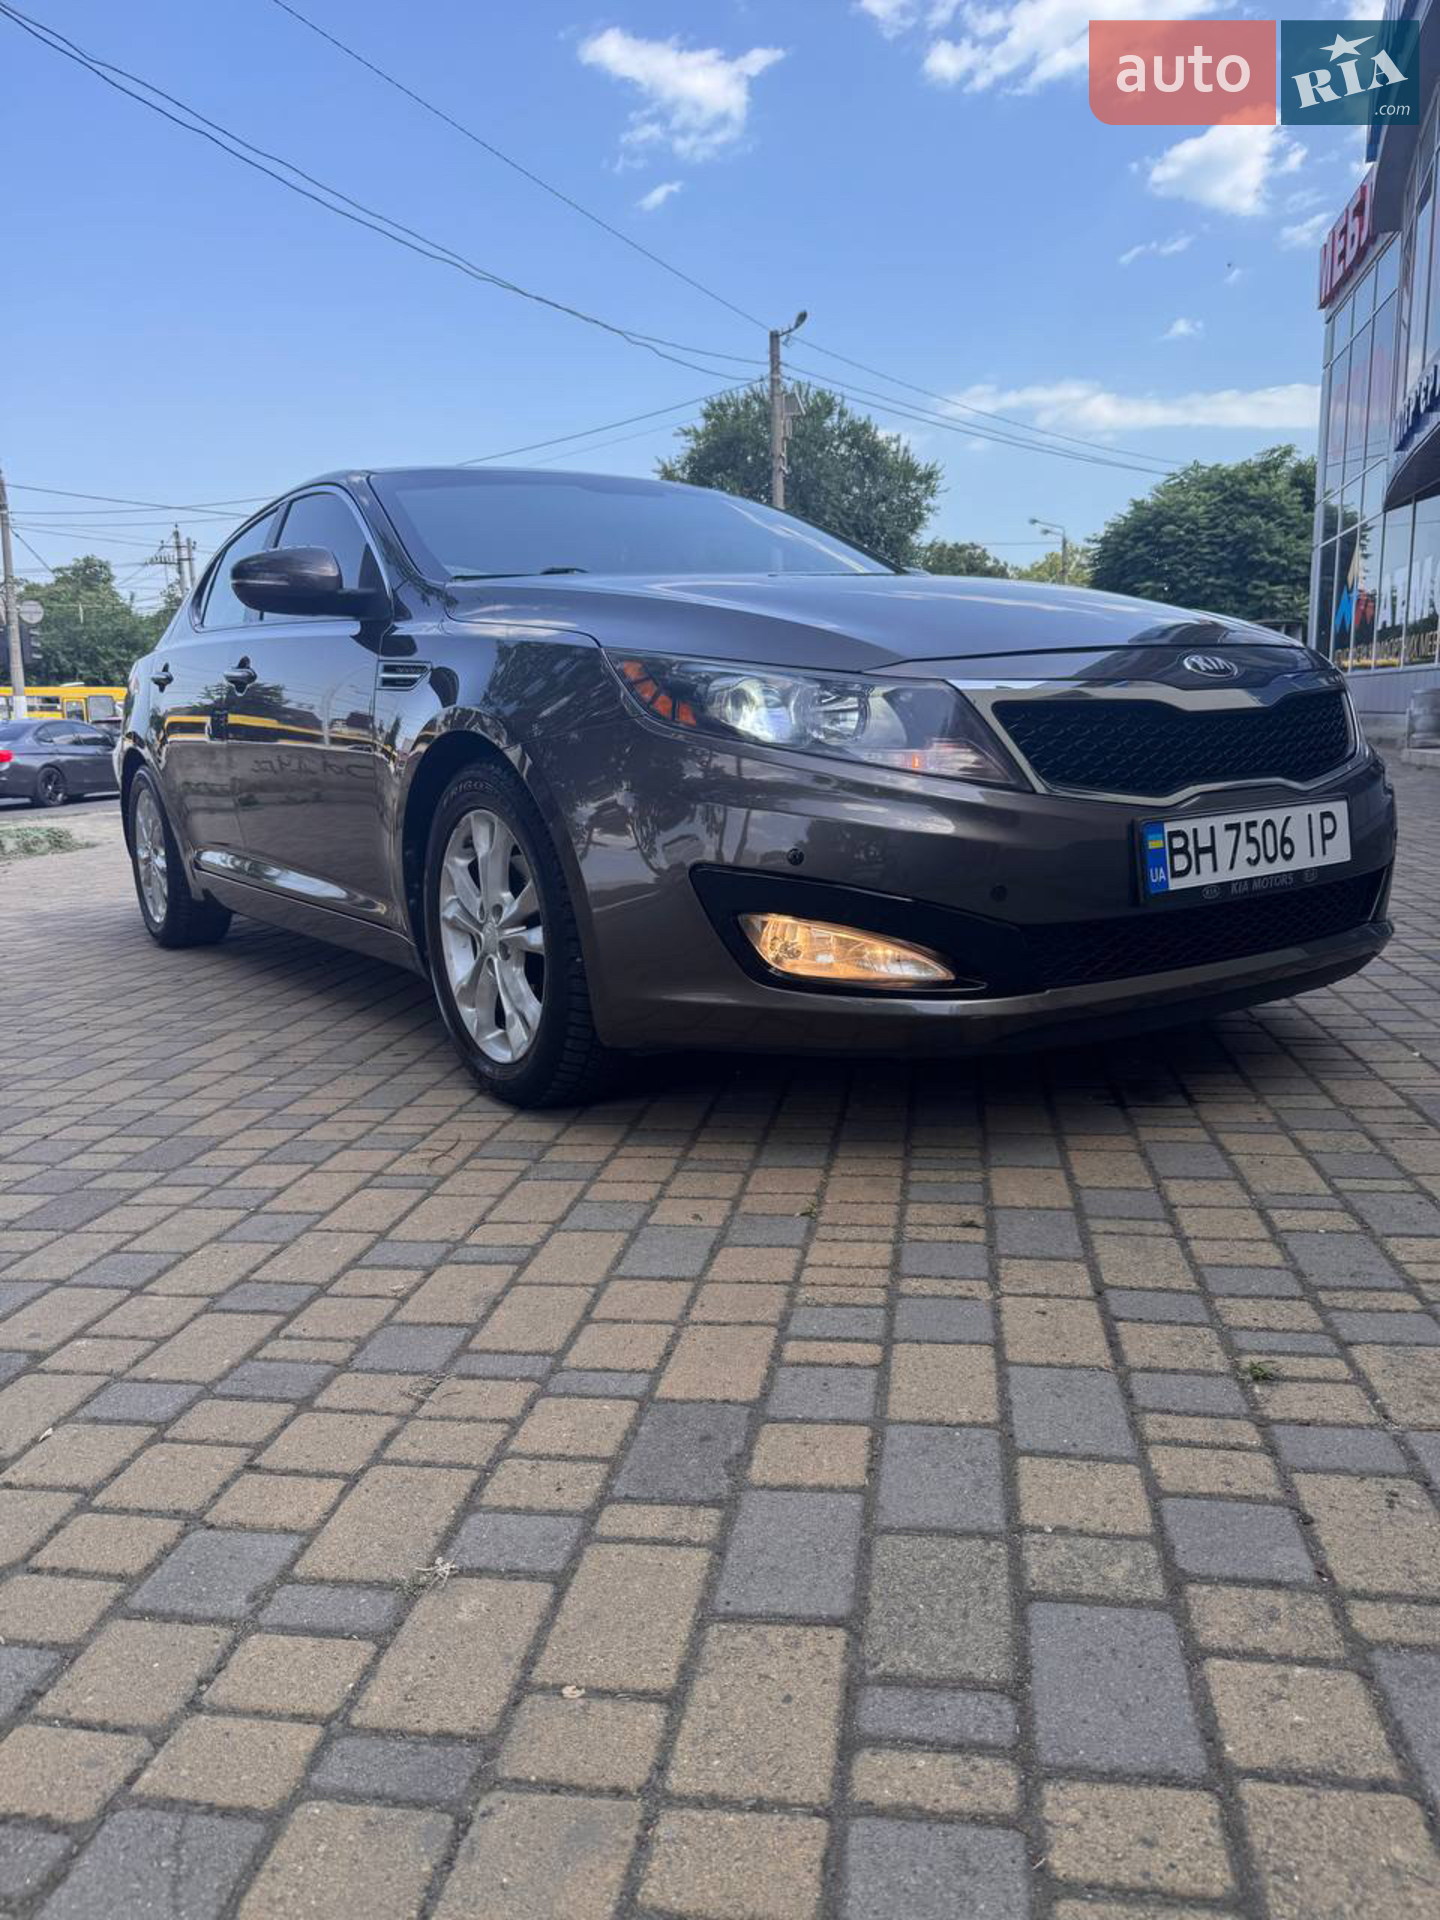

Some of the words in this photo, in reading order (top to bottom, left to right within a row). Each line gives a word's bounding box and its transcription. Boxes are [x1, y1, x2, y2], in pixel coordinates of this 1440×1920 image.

[1194, 656, 1232, 671] KIA
[1167, 825, 1218, 879] BH
[1224, 816, 1295, 870] 7506
[1308, 811, 1338, 857] IP
[1150, 868, 1166, 883] UA
[1231, 881, 1249, 895] KIA
[1252, 873, 1294, 891] MOTORS
